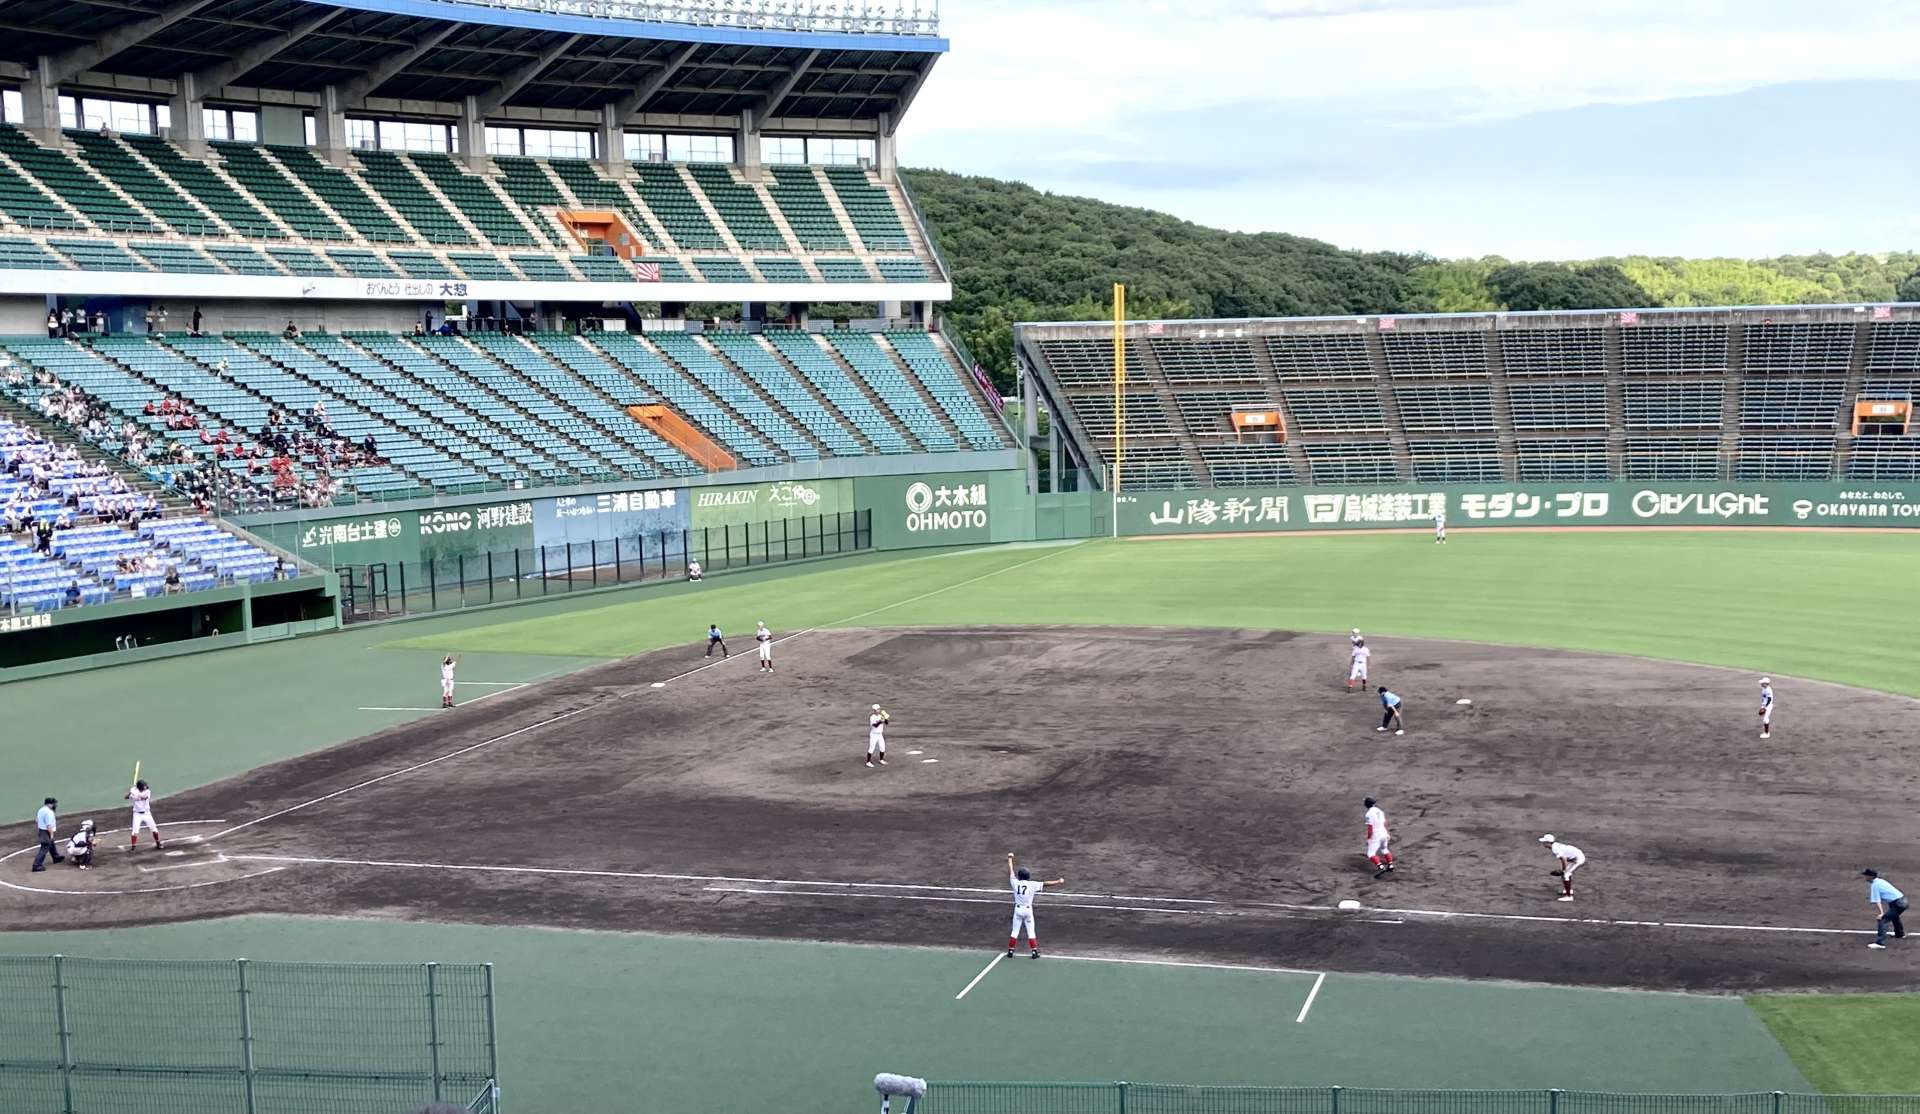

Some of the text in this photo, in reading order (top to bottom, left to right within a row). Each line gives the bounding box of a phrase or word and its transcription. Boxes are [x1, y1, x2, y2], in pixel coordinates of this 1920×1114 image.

[597, 489, 676, 513] 三浦自動車
[697, 490, 760, 507] HIRAKIN
[1817, 503, 1888, 517] OKAYAMA
[476, 502, 533, 529] 河野建設
[906, 509, 987, 532] OHMOTO
[1149, 496, 1289, 525] 山陽新聞
[1017, 885, 1028, 895] 17
